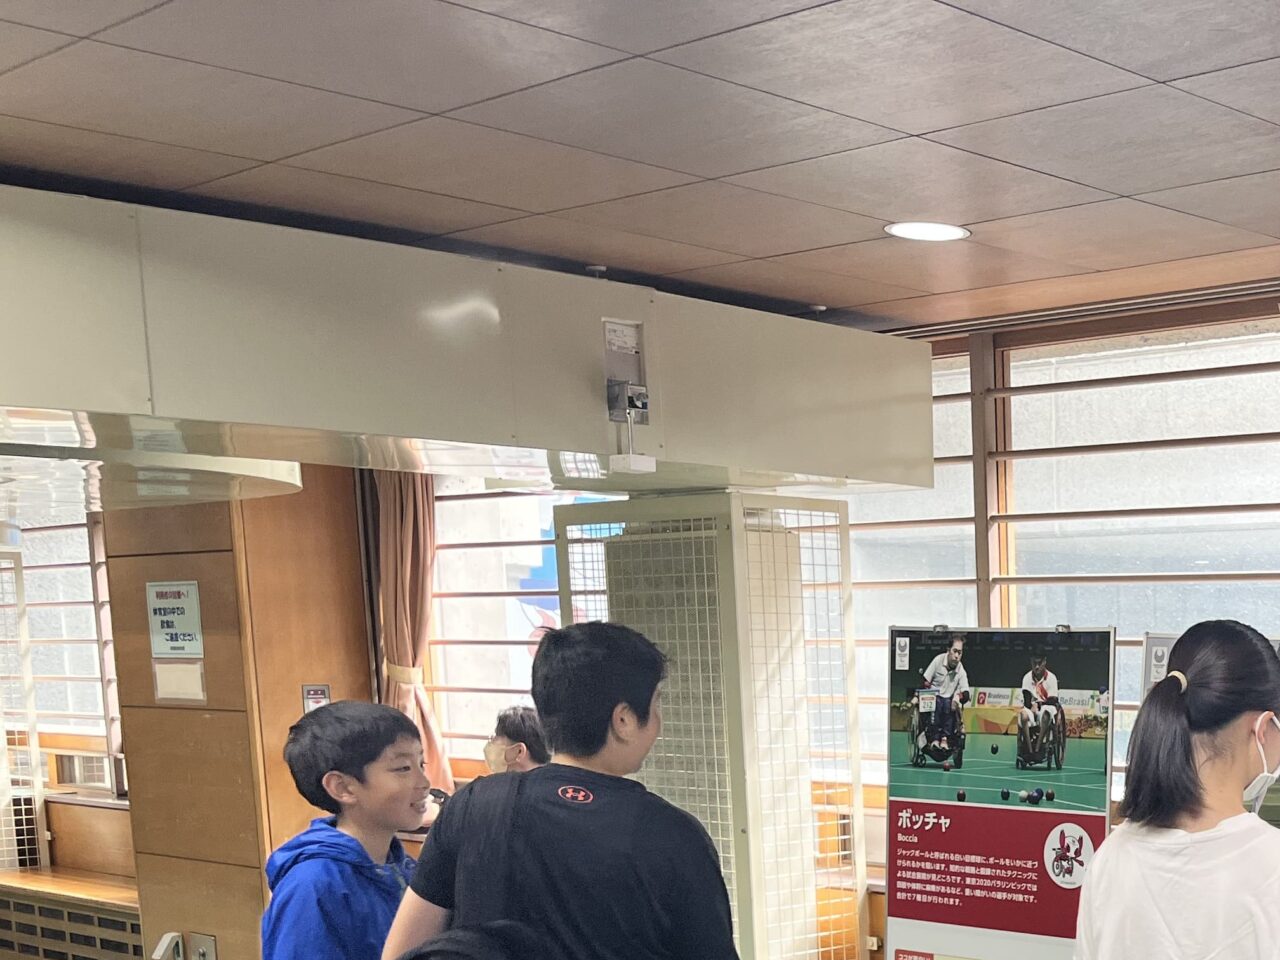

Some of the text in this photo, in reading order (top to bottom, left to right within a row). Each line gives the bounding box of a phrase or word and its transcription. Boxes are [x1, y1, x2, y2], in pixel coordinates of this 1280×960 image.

[897, 808, 951, 832] ボッチャ
[897, 833, 918, 843] Boccia
